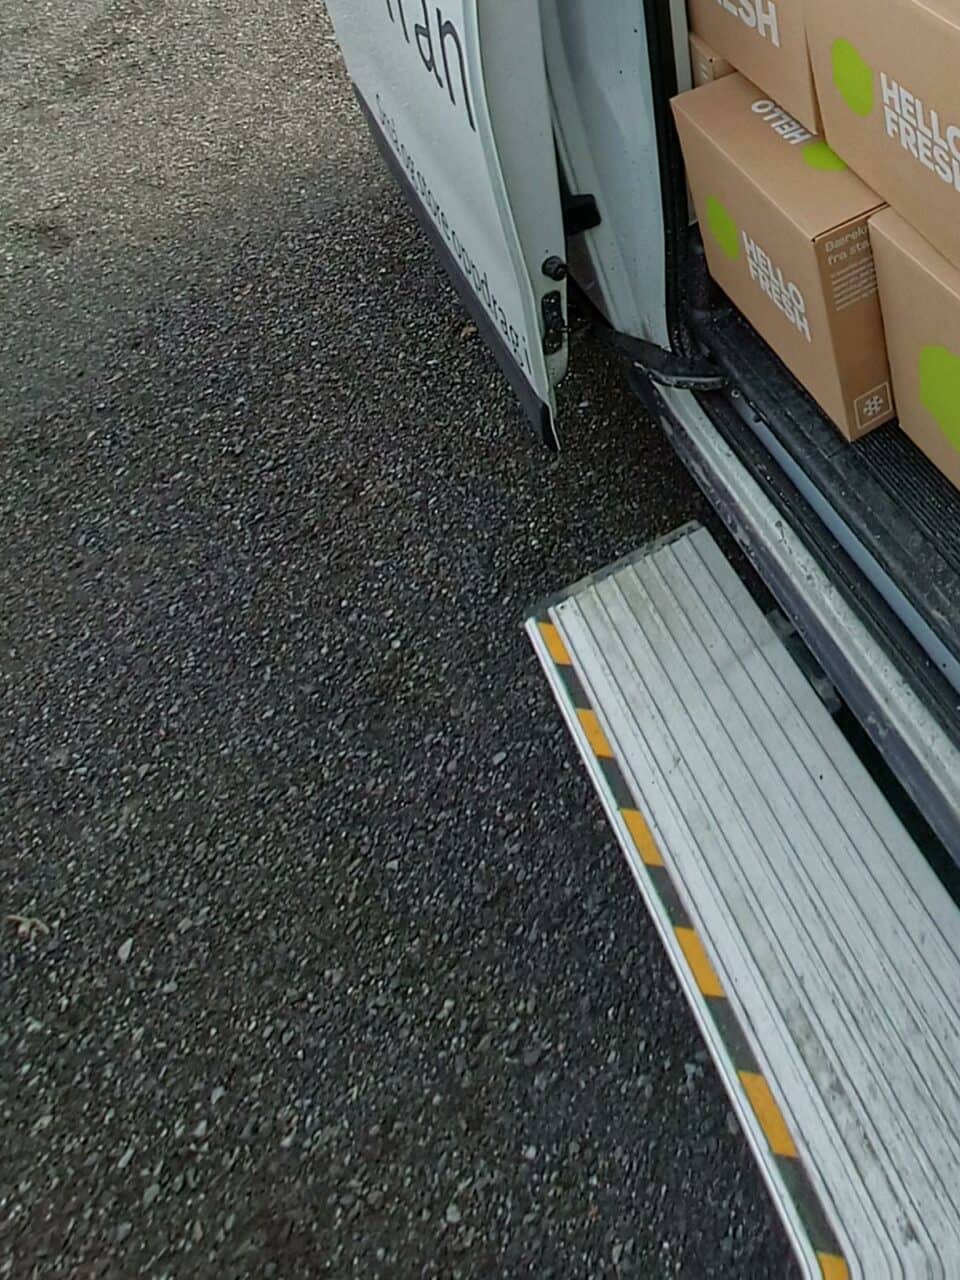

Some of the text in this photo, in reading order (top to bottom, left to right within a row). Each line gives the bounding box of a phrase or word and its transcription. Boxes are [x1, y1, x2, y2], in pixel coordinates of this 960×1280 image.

[751, 99, 813, 145] HELLO
[741, 229, 805, 314] HELLO
[745, 256, 812, 344] FRESH
